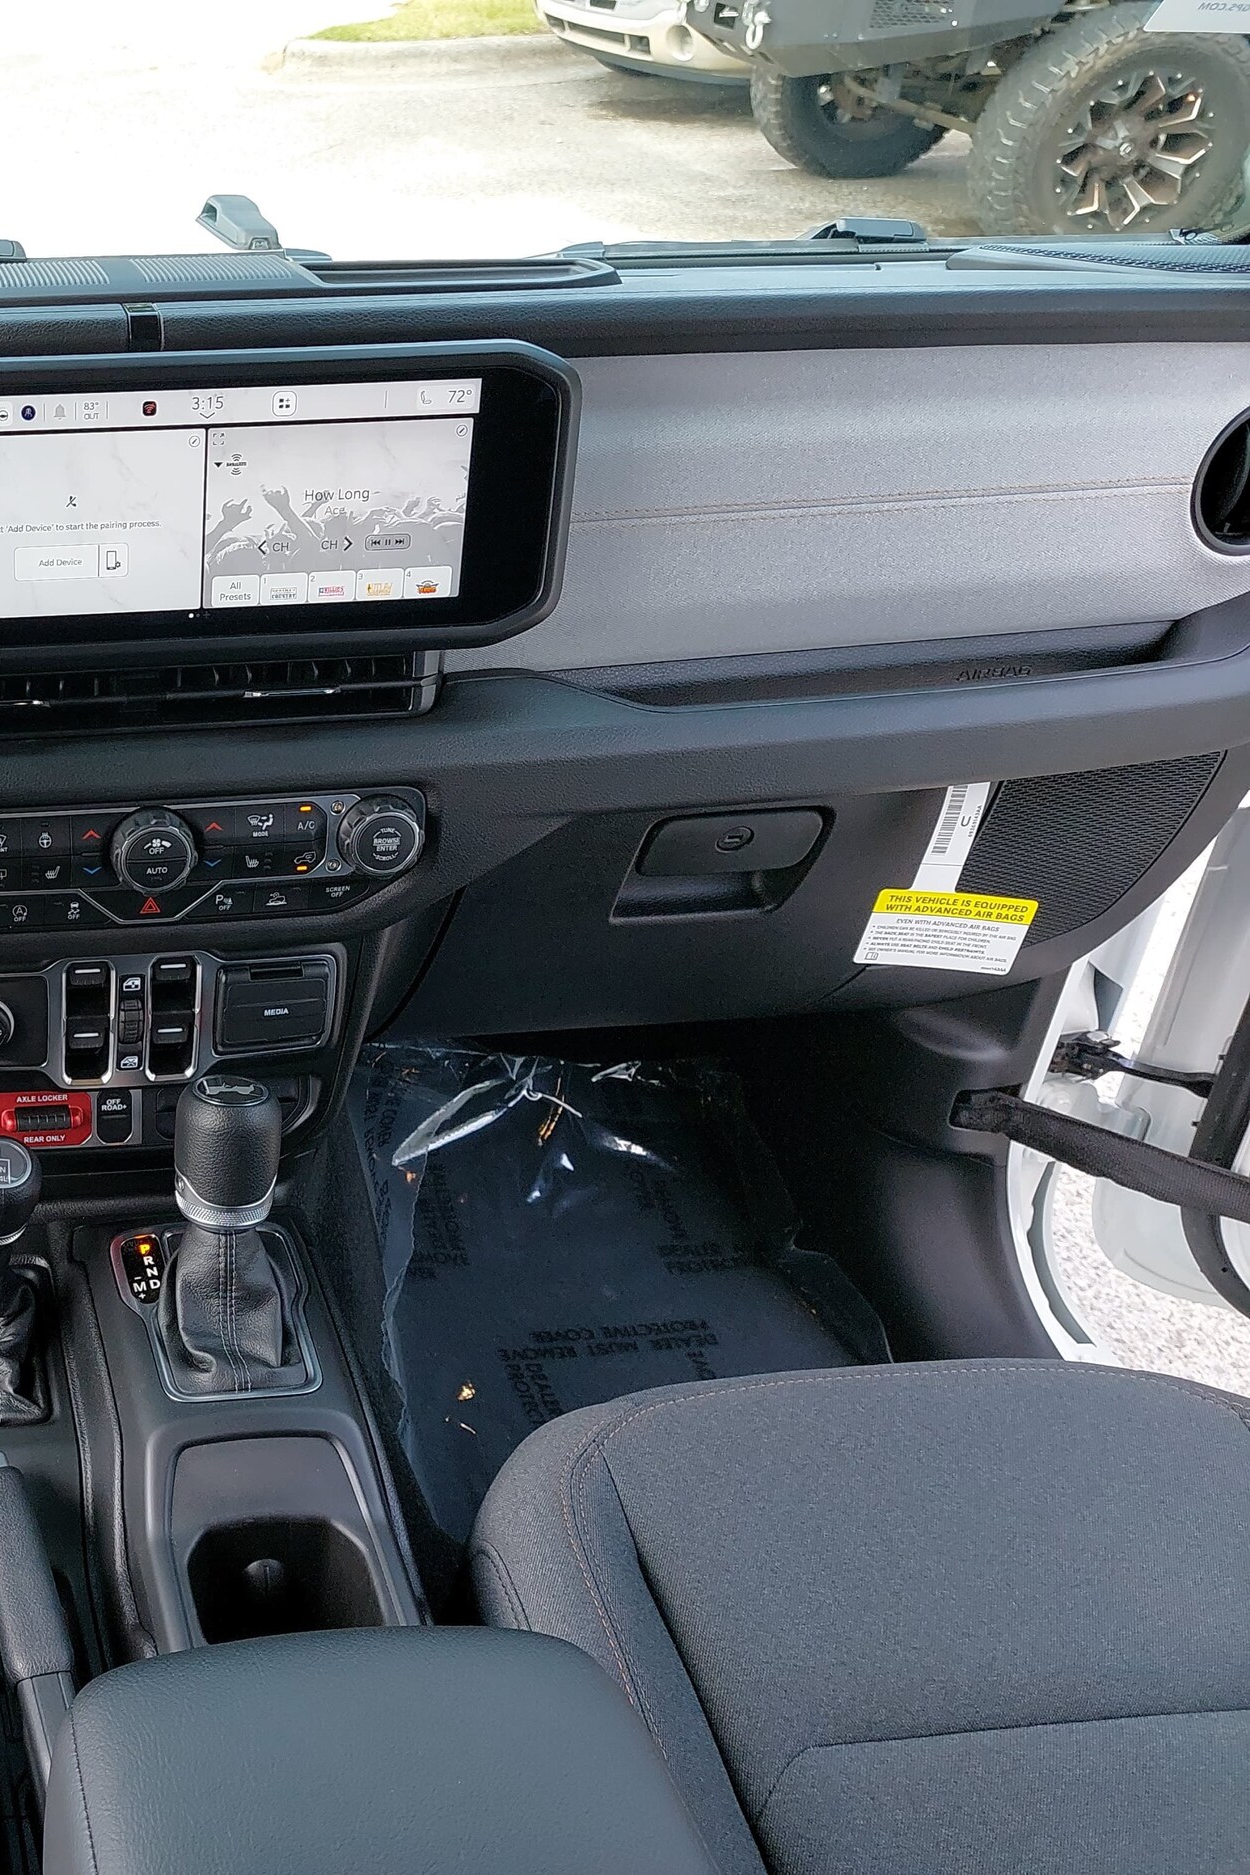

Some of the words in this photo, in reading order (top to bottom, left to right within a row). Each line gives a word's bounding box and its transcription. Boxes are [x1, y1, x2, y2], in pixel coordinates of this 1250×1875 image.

[448, 390, 472, 404] 72°
[84, 402, 100, 410] 83°
[192, 396, 224, 410] 3:15
[84, 412, 100, 420] OUT
[304, 490, 334, 501] How
[338, 488, 370, 502] Long
[324, 506, 345, 515] Ace
[86, 522, 98, 530] the
[100, 521, 127, 531] pairing
[129, 520, 162, 530] process.
[272, 542, 289, 552] CH
[321, 540, 338, 550] CH
[56, 558, 82, 566] Device
[229, 582, 242, 590] All
[219, 592, 252, 601] Presets
[956, 665, 1032, 682] AIRBAG
[298, 821, 315, 830] A/C
[960, 815, 972, 827] U
[373, 836, 400, 844] BROWSE
[149, 847, 164, 855] OFF
[216, 895, 224, 904] P
[888, 894, 912, 903] THIS
[915, 896, 958, 906] VEHICLE
[974, 901, 1028, 913] EQUIPPED
[886, 904, 912, 912] WITH
[914, 906, 972, 916] ADVANCED
[974, 910, 994, 918] AIR
[996, 912, 1024, 922] BAGS
[932, 920, 968, 930] ADVANCED
[264, 1008, 289, 1016] MEDIA
[140, 1244, 150, 1254] P
[143, 1256, 155, 1266] R
[146, 1266, 158, 1277] N
[132, 1281, 147, 1292] M
[149, 1280, 160, 1289] D
